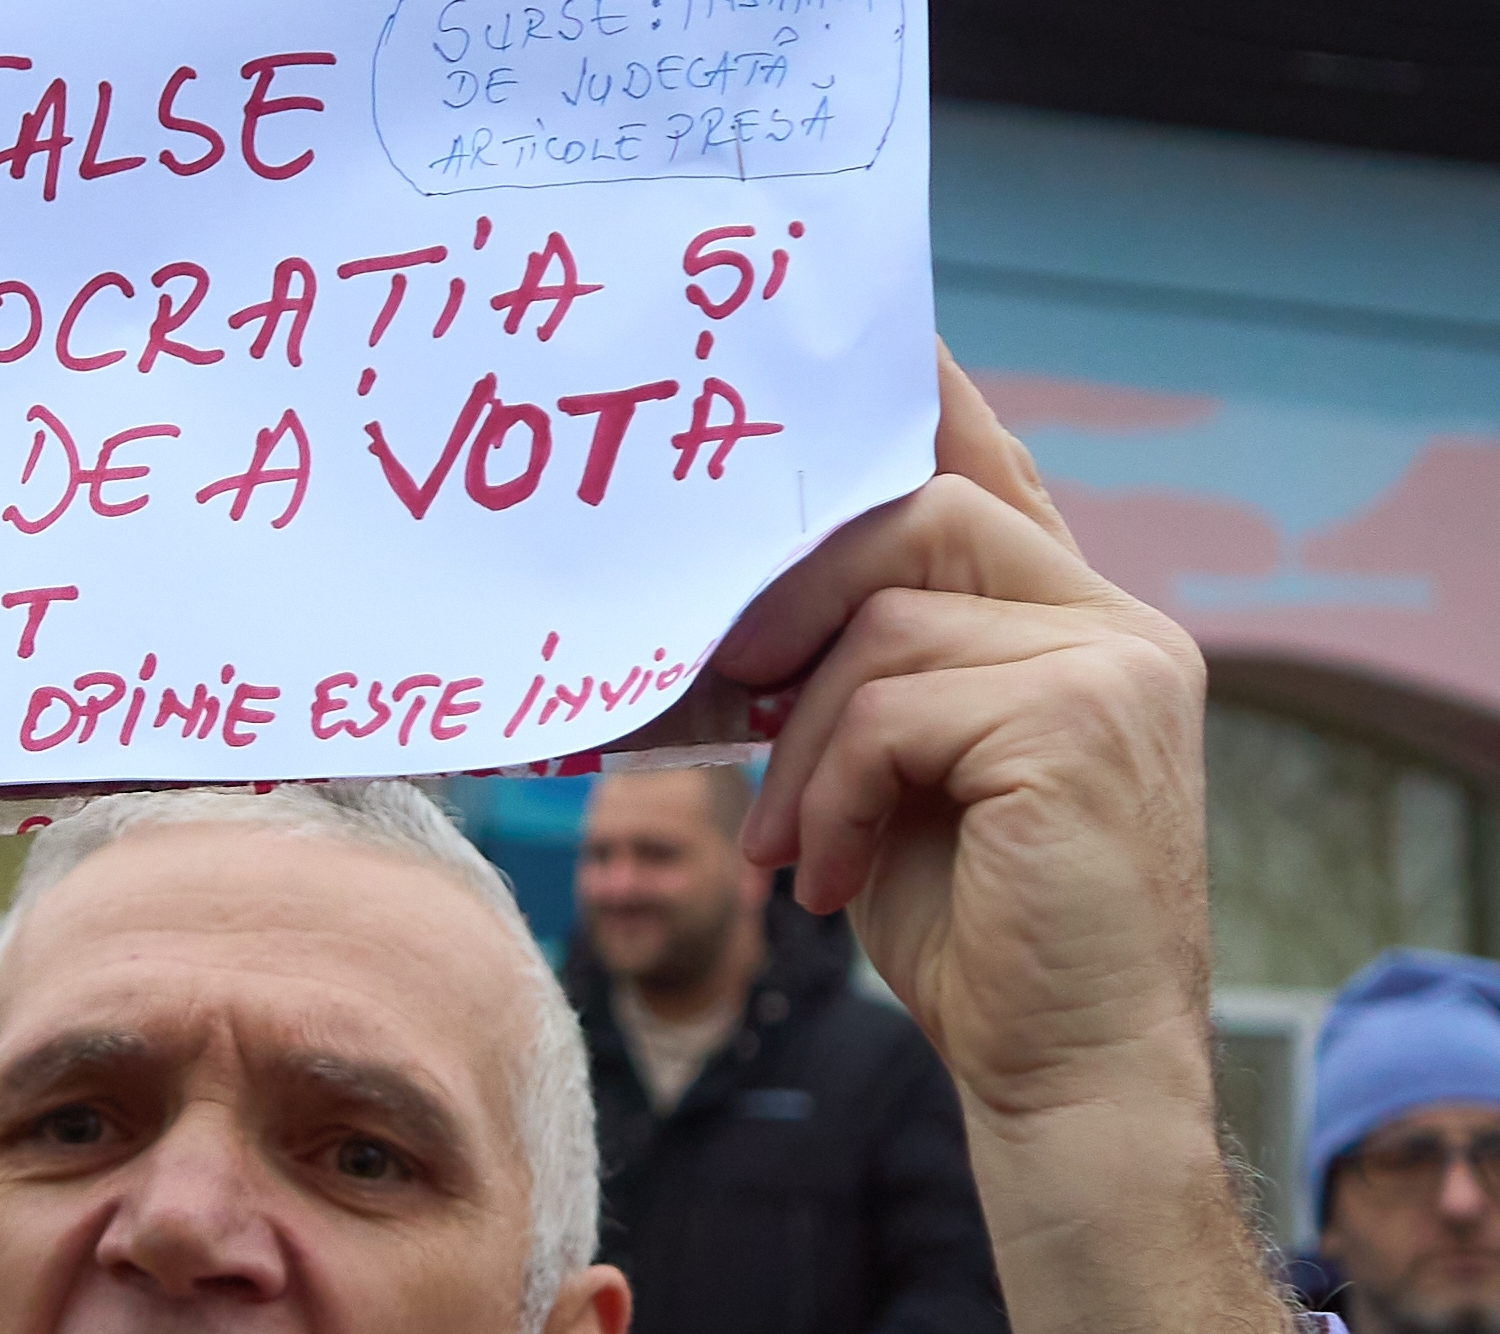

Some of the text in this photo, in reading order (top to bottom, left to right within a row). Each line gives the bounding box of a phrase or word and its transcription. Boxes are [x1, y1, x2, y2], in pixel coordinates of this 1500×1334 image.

[442, 66, 521, 110] DE
[2, 404, 181, 535] DE
[195, 409, 311, 529] A
[310, 672, 483, 746] ESTE
